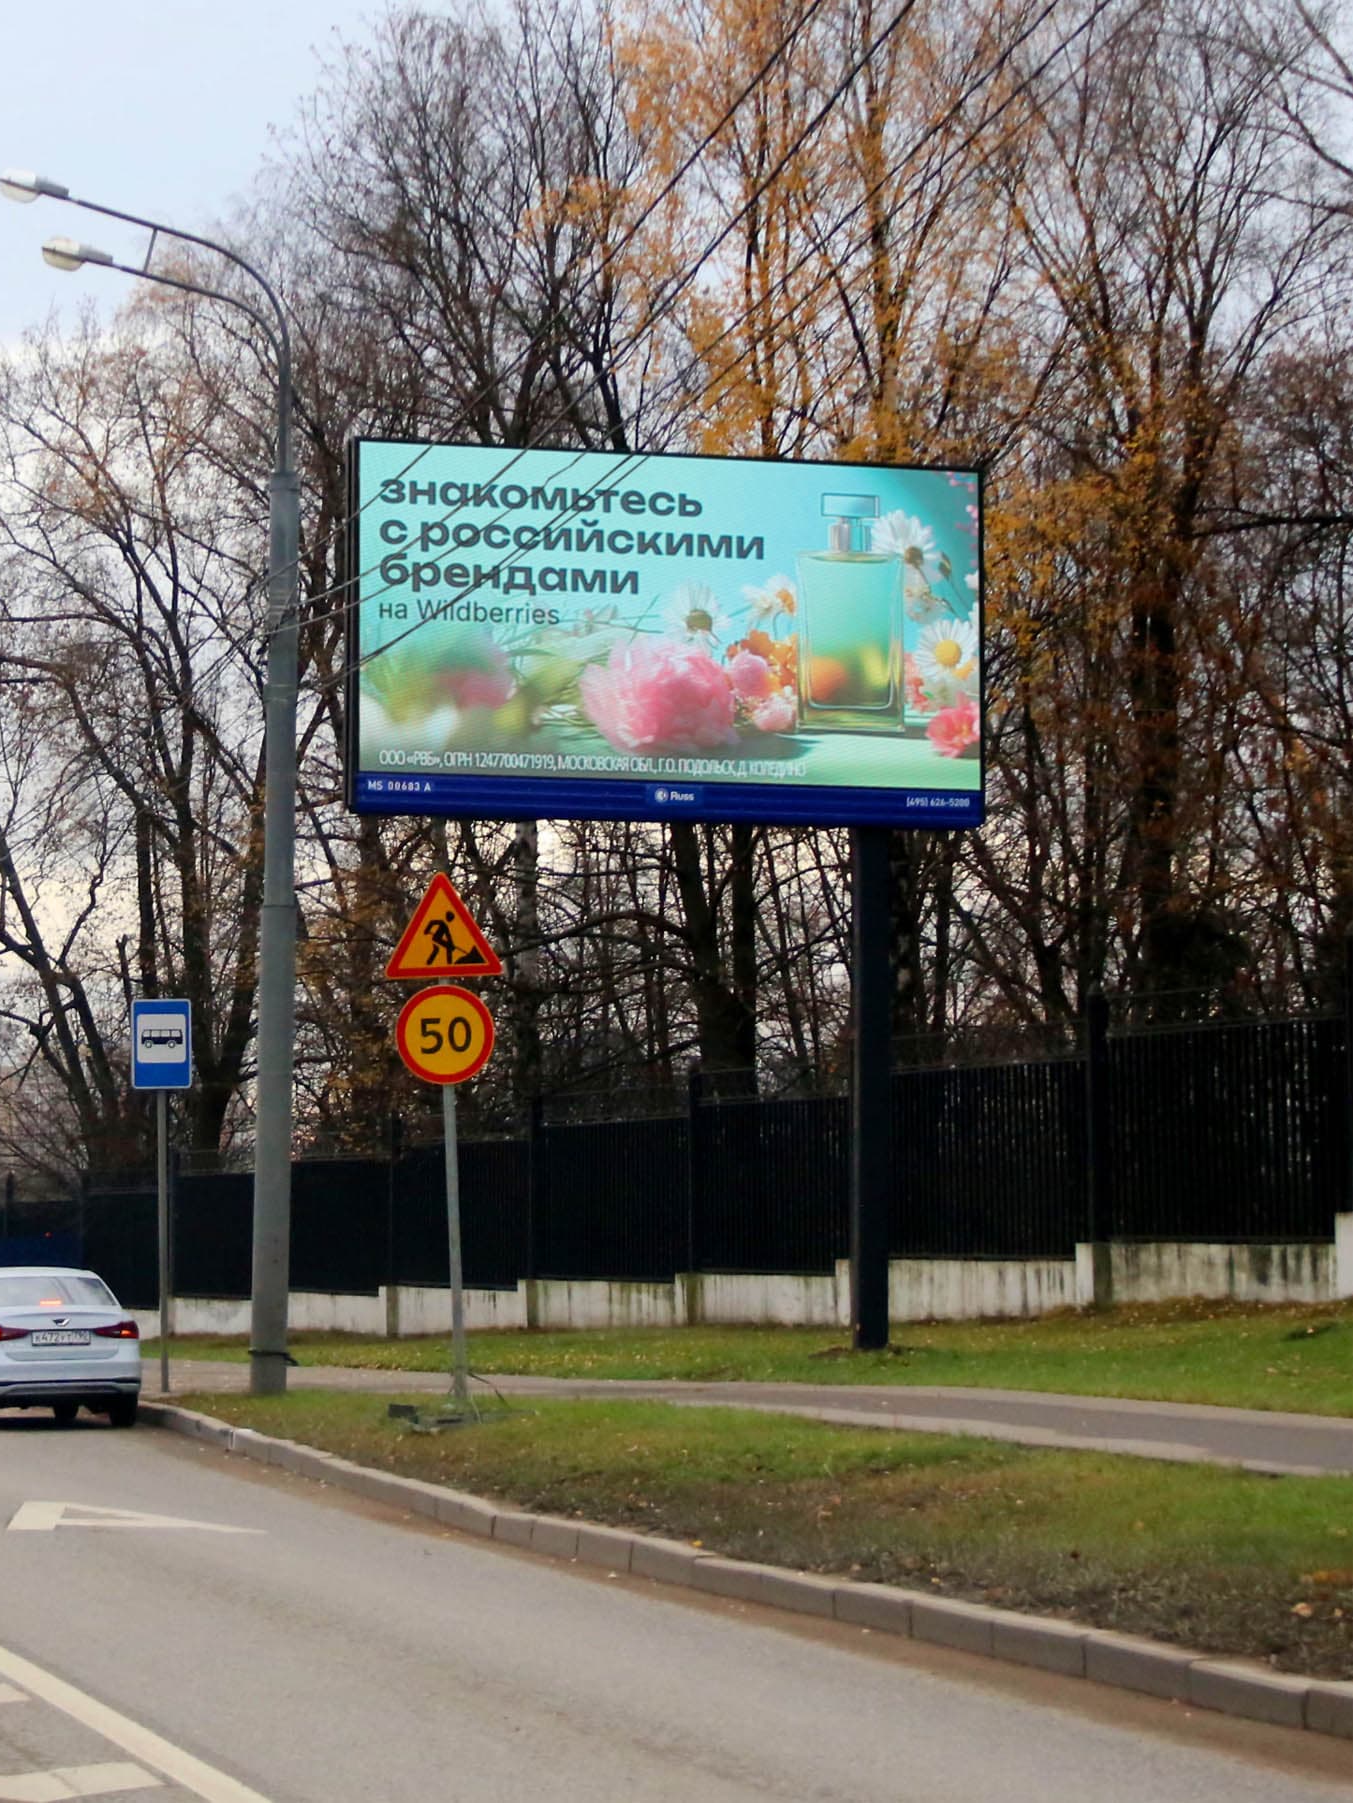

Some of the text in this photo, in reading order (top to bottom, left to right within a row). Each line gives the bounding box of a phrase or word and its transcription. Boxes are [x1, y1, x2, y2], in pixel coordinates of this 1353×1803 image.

[379, 478, 703, 518] знакомьтесь
[379, 518, 765, 561] с российскими
[380, 552, 640, 596] брендами
[379, 600, 560, 625] на Wildberries
[379, 750, 405, 766] ООО
[670, 791, 695, 801] Russ
[420, 1016, 472, 1055] 50
